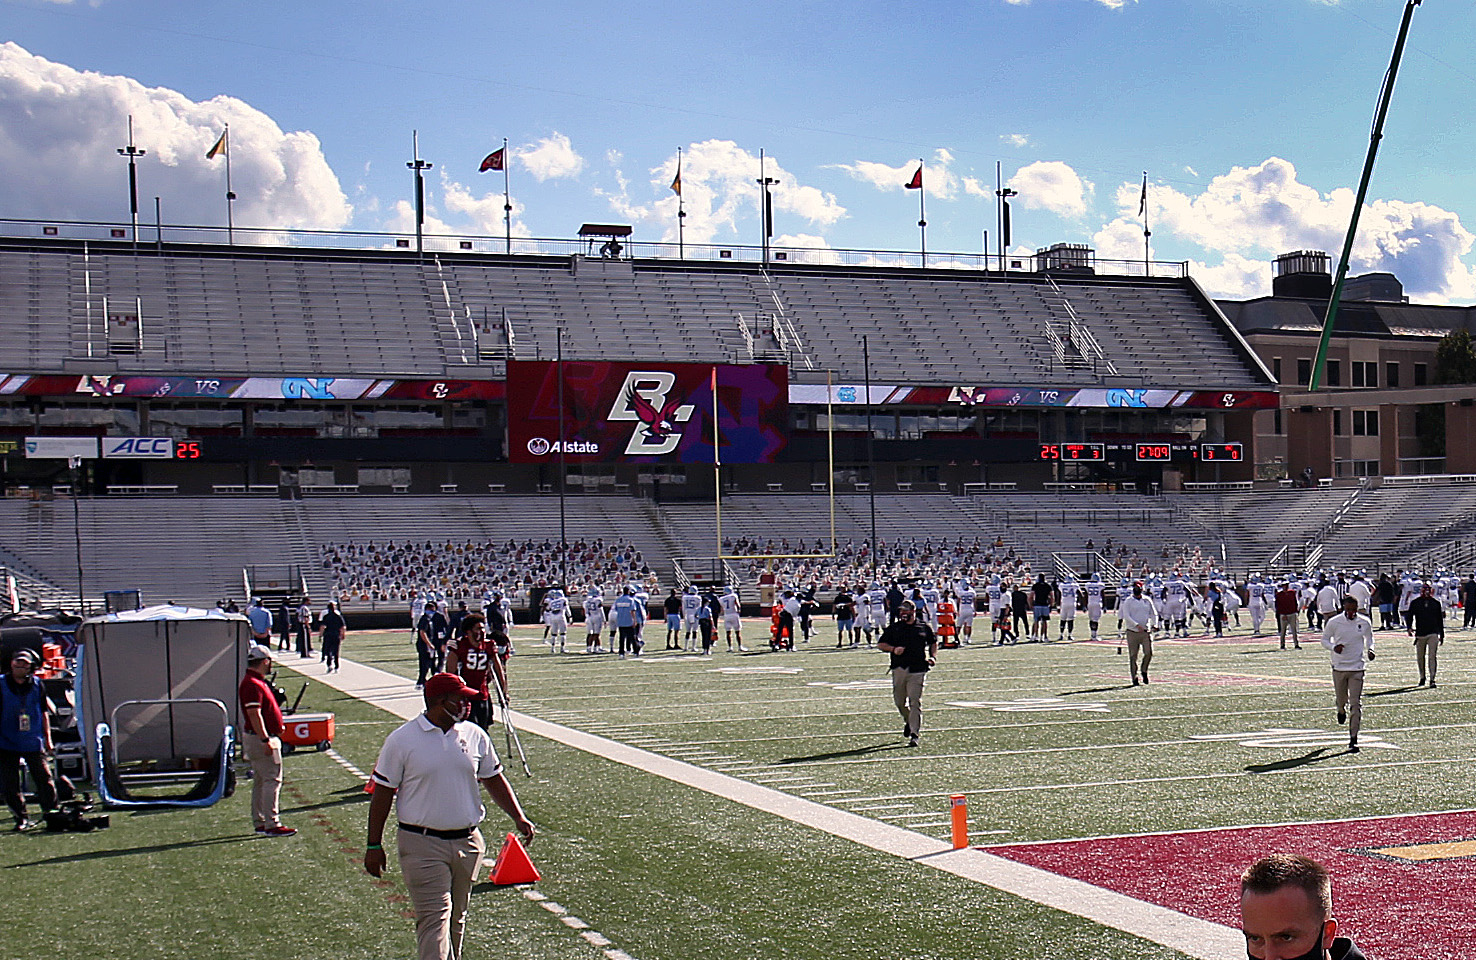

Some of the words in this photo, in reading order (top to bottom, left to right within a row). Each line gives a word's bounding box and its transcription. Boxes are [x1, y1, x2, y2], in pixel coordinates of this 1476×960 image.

[194, 380, 220, 394] VS
[1039, 391, 1058, 403] VS
[111, 438, 169, 453] ACC
[177, 442, 199, 458] 25
[550, 440, 598, 453] Alstate
[1041, 446, 1059, 459] 25
[1139, 446, 1169, 459] 27:09
[466, 651, 488, 670] 92
[294, 723, 310, 739] G
